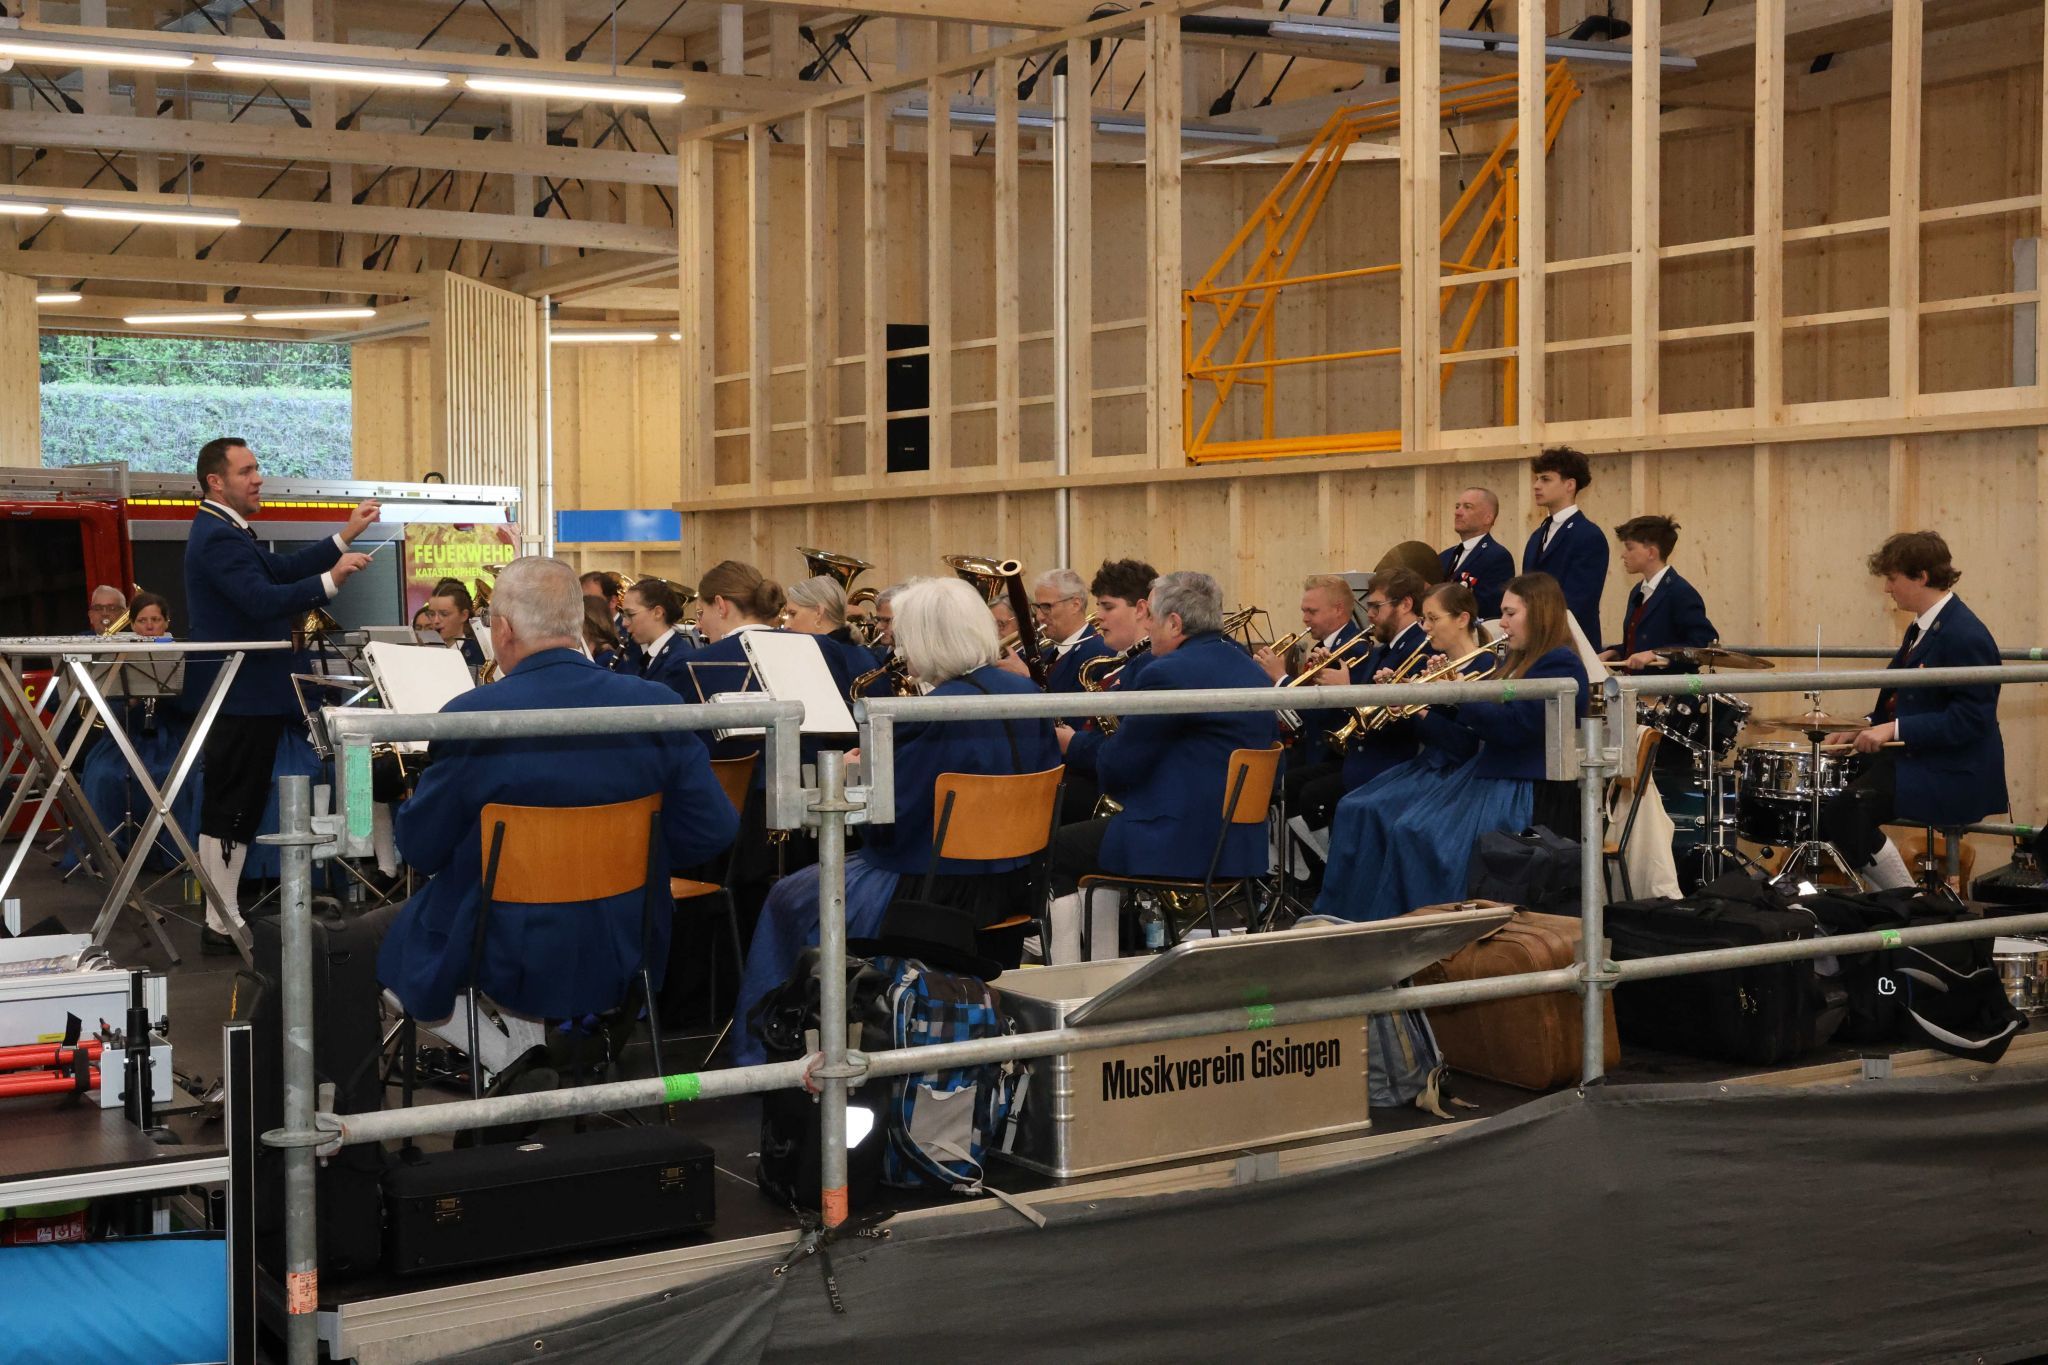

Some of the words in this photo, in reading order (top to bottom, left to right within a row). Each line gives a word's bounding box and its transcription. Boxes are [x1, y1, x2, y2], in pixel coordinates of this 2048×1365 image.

[414, 543, 515, 564] FEUERWEHR
[1102, 1046, 1245, 1102] Musikverein
[1251, 1037, 1341, 1078] Gisingen
